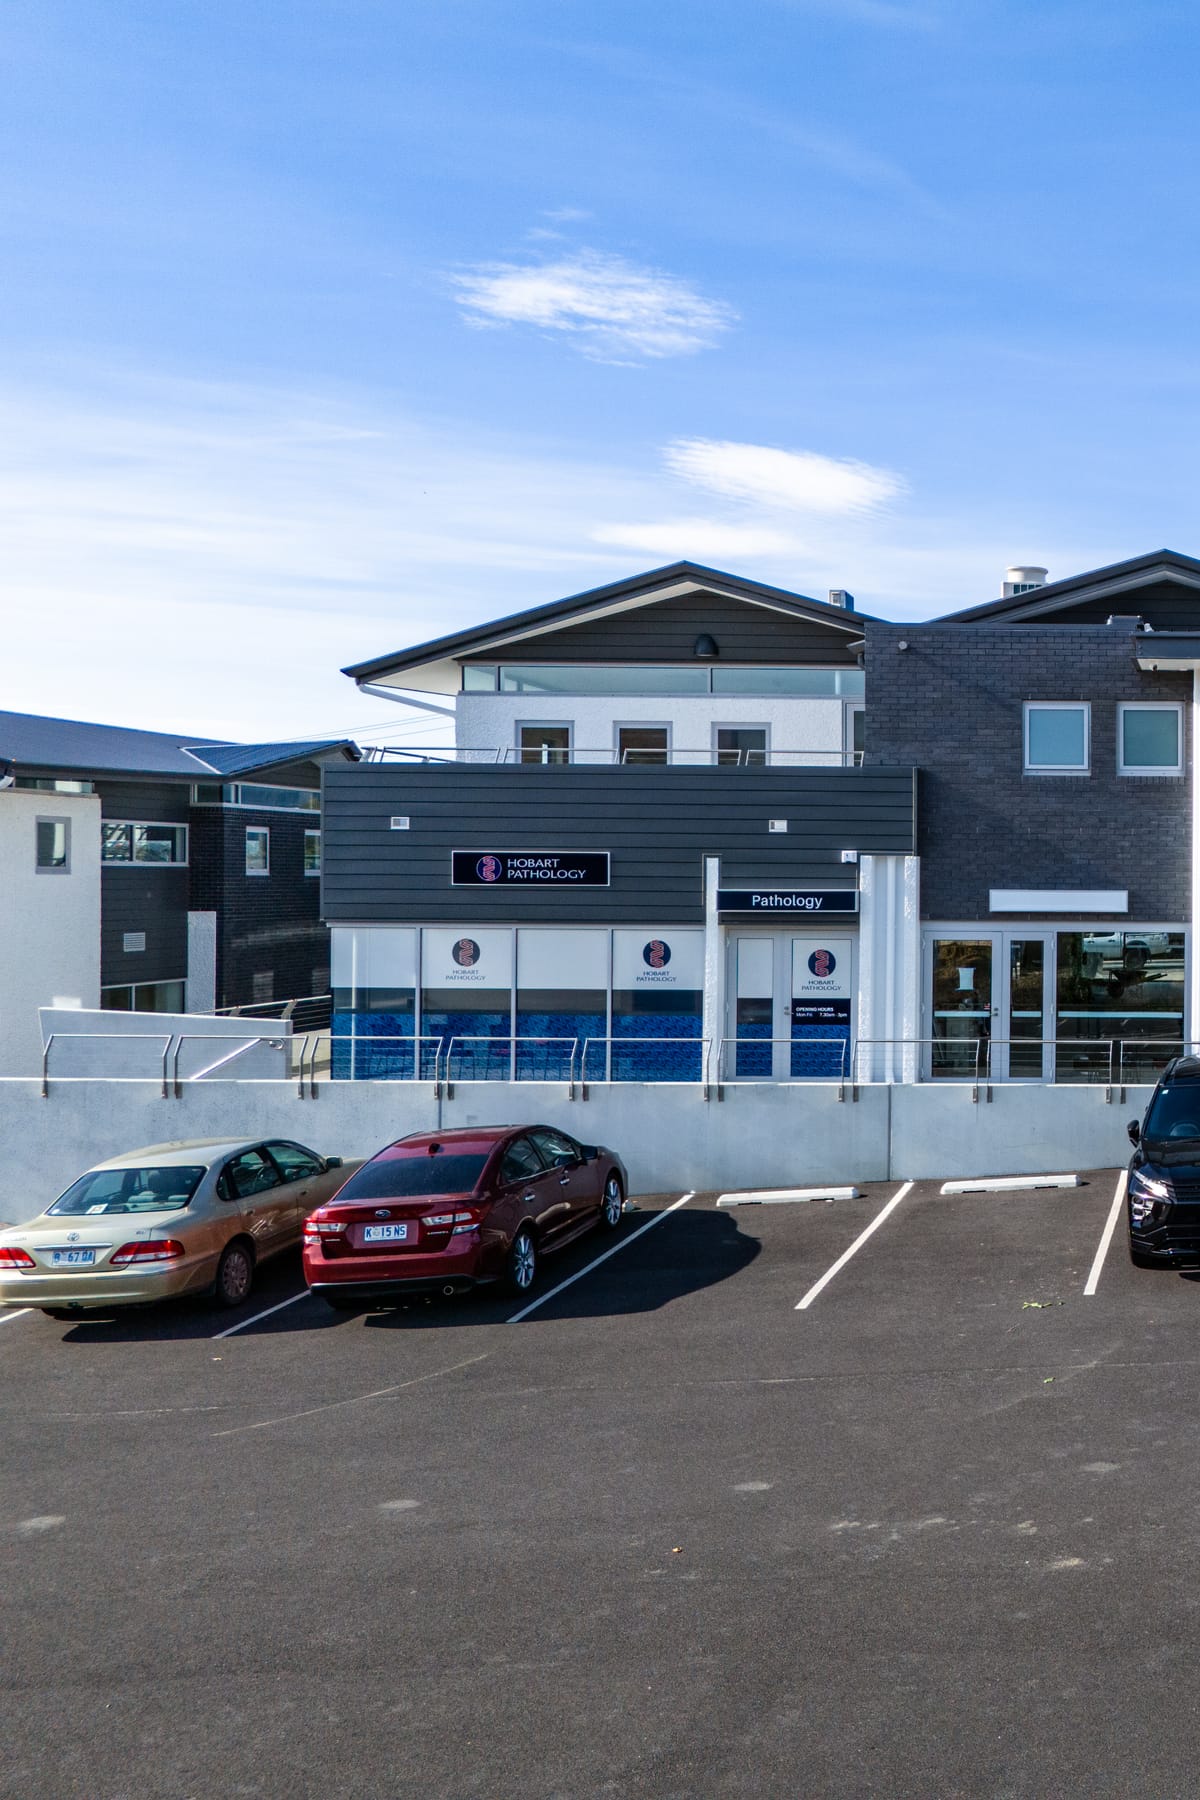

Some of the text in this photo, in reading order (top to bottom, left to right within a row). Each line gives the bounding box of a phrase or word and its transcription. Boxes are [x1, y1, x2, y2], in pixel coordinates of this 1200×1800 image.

[507, 858, 560, 868] HOBART
[507, 869, 586, 879] PATHOLOGY
[752, 894, 823, 909] Pathology
[366, 1226, 406, 1238] K 15 NS
[68, 1252, 80, 1262] 67
